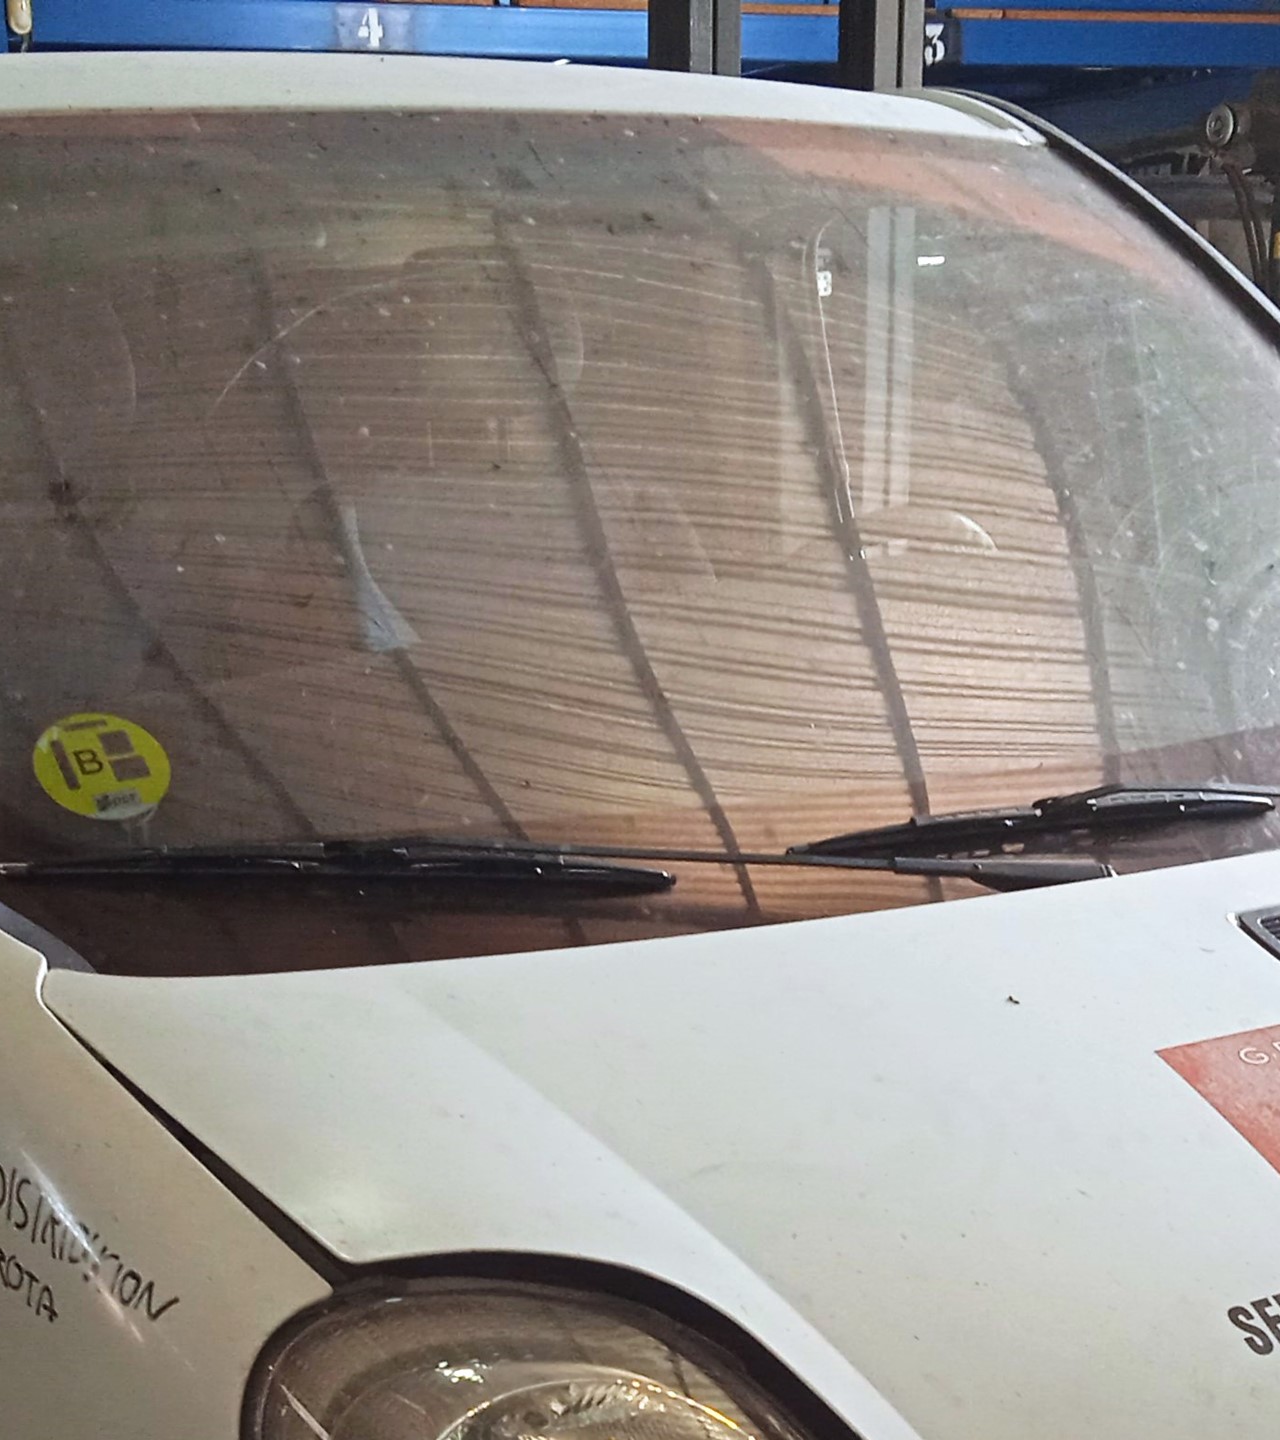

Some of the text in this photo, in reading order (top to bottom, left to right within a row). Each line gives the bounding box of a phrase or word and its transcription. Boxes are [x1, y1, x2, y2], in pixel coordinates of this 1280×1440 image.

[357, 6, 384, 48] 4
[924, 22, 945, 67] 3
[71, 748, 104, 776] B
